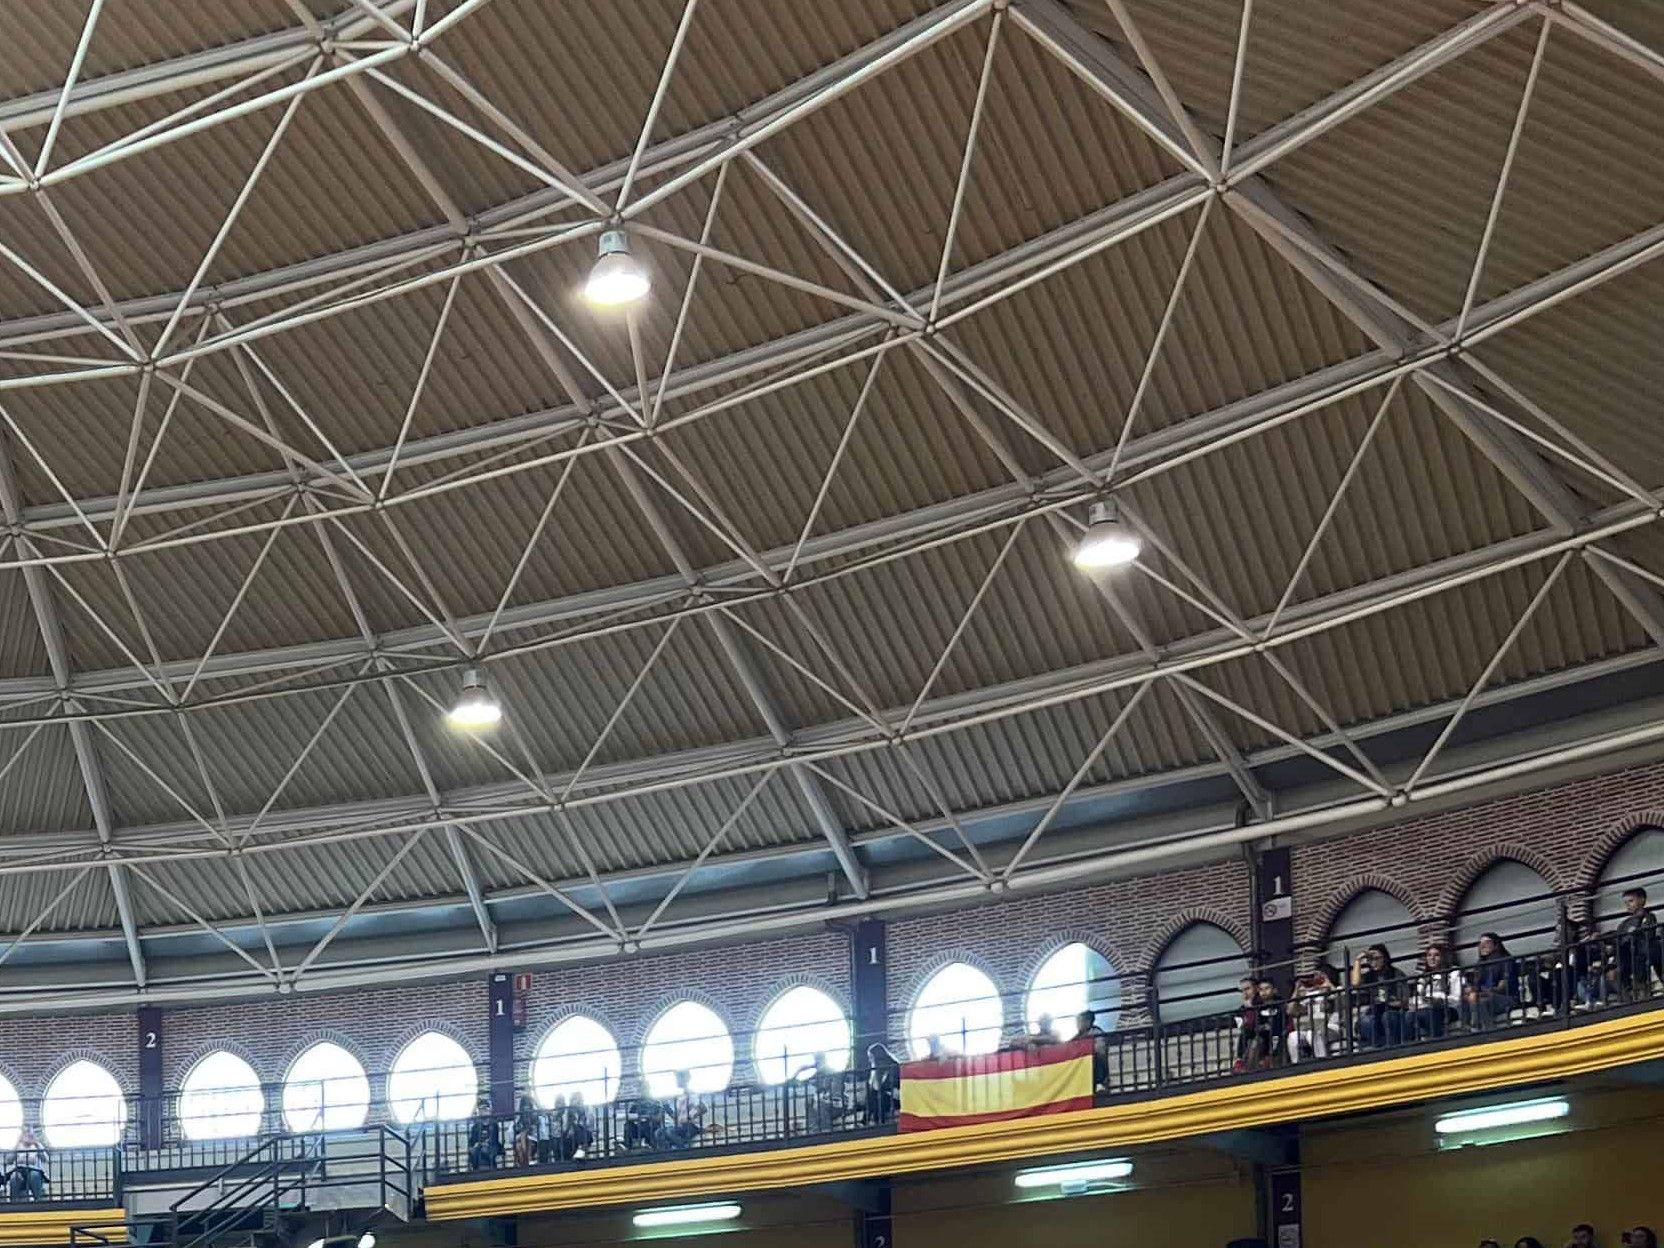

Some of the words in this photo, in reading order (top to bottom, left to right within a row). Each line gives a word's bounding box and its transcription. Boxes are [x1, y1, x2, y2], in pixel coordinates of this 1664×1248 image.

[1274, 876, 1283, 895] 1
[870, 947, 879, 964] 1
[496, 999, 505, 1016] 1
[146, 1032, 156, 1048] 2
[1282, 1193, 1293, 1212] 2
